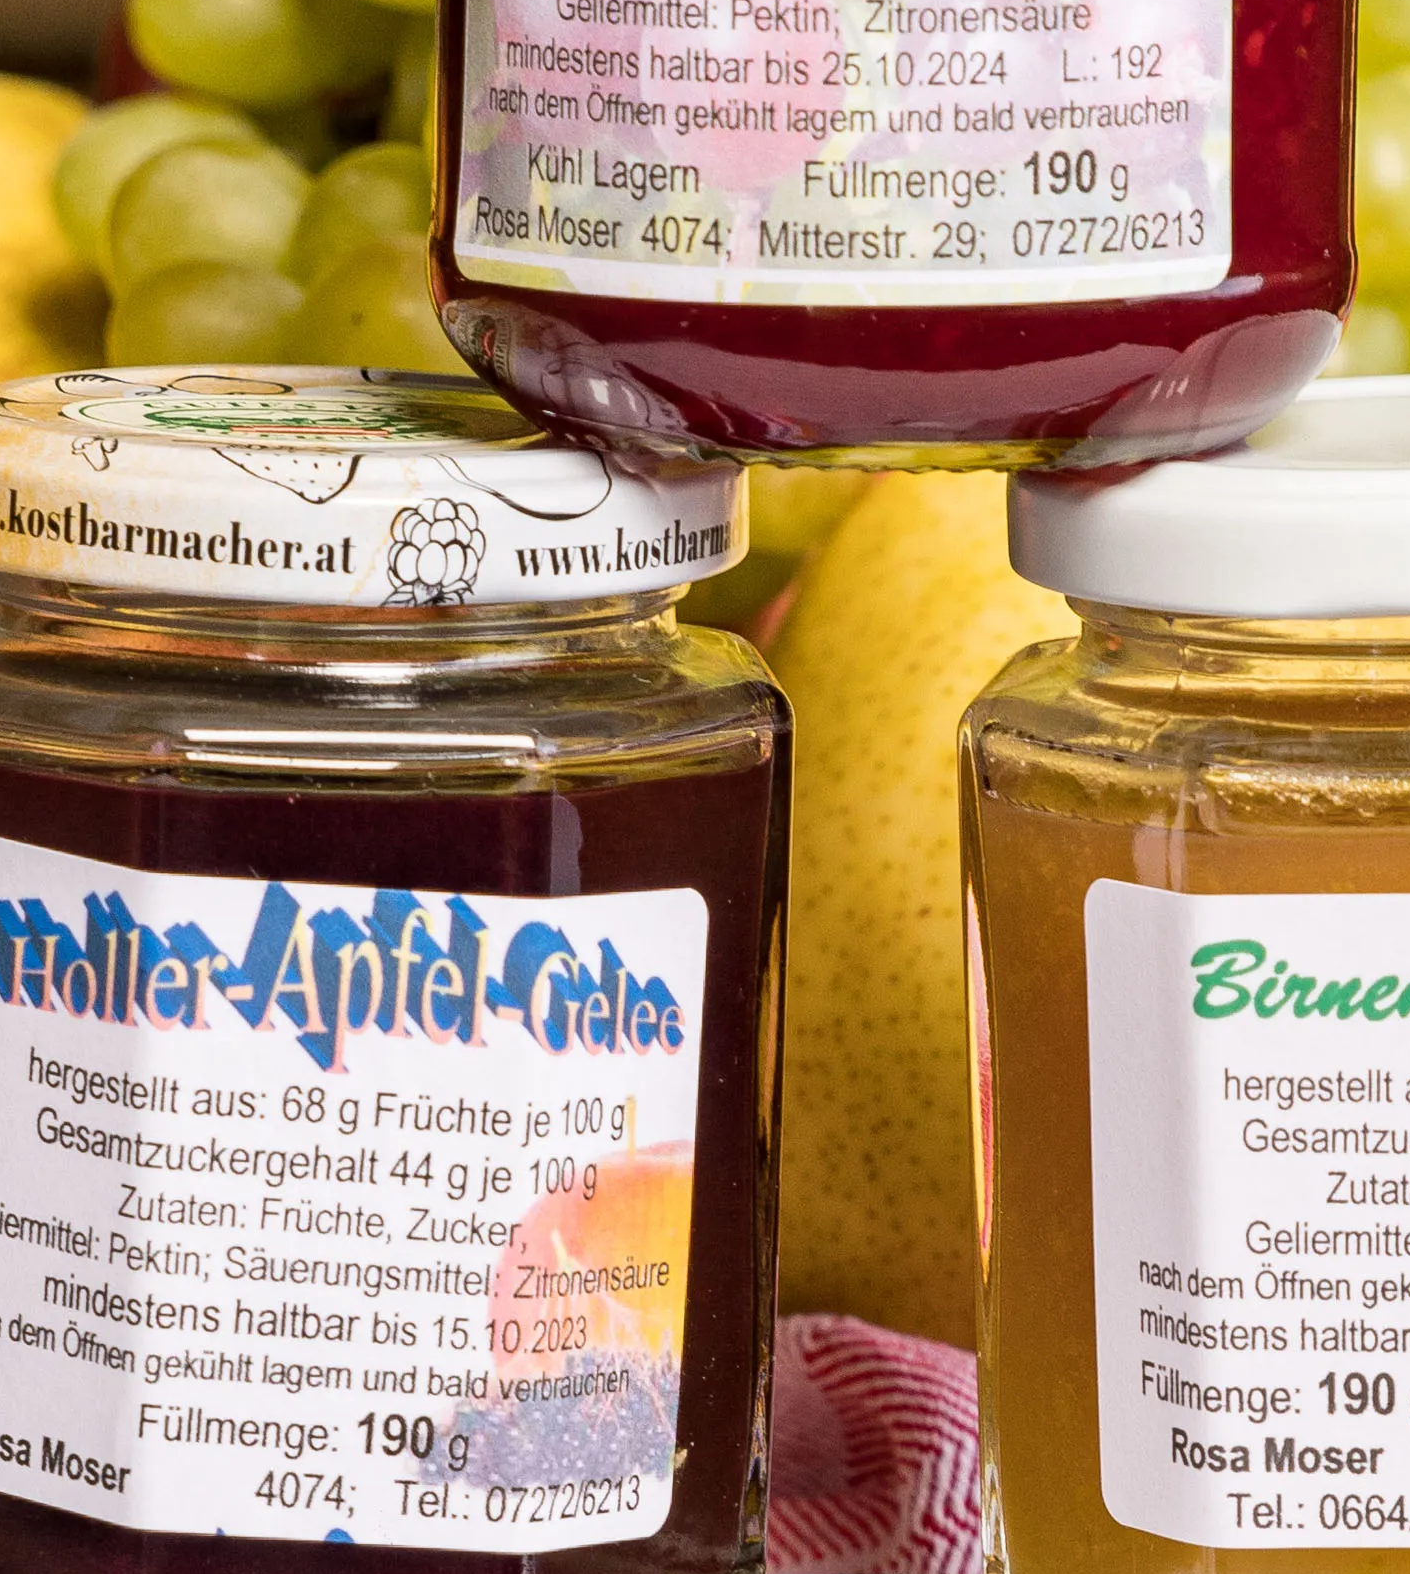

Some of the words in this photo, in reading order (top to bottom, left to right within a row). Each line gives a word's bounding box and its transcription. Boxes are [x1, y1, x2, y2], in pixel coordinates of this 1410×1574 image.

[506, 37, 640, 79] mindestens
[650, 45, 753, 84] haltbar
[765, 51, 809, 86] bis
[822, 51, 1007, 87] 25.10.2024
[1111, 43, 1162, 79] 192
[528, 142, 583, 186] Kühl
[593, 149, 700, 202] Lagern
[804, 160, 1009, 209] Füllmenge:
[1023, 149, 1098, 195] 190
[1110, 164, 1128, 203] g
[474, 195, 530, 240] Rosa
[538, 205, 623, 249] Moser
[640, 214, 732, 262] 4074;
[759, 220, 917, 260] Mitterstr.
[932, 221, 986, 264] 29;
[1012, 208, 1204, 258] 07272/6213
[36, 1108, 380, 1190] Gesamtzuckergehalt
[389, 1150, 434, 1188] 44
[446, 1163, 468, 1201] g
[477, 1156, 512, 1203] je
[529, 1156, 575, 1195] 100
[582, 1163, 597, 1201] g
[117, 1183, 248, 1228] Zutaten:
[260, 1197, 391, 1244] Früchte,
[405, 1207, 527, 1250] Zucker,
[108, 1231, 209, 1282] Pektin;
[224, 1245, 503, 1298] Säuerungsmittel:
[512, 1261, 670, 1299] Zitronensäure
[43, 1272, 220, 1333] mindestens
[234, 1304, 361, 1342] haltbar
[372, 1311, 417, 1347] bis
[433, 1315, 587, 1354] 15.10.2023
[1140, 1304, 1288, 1351] mindestens
[1141, 1359, 1301, 1424] Füllmenge:
[1318, 1371, 1396, 1416] 190
[40, 1435, 132, 1494] Moser
[138, 1403, 339, 1460] Füllmenge:
[357, 1411, 437, 1463] 190
[447, 1425, 472, 1474] g
[1171, 1426, 1250, 1474] Rosa
[1264, 1436, 1385, 1475] Moser
[254, 1470, 356, 1519] 4074;
[394, 1479, 470, 1520] Tel.:
[485, 1474, 641, 1523] 07272/6213
[1226, 1492, 1305, 1529] Tel.:
